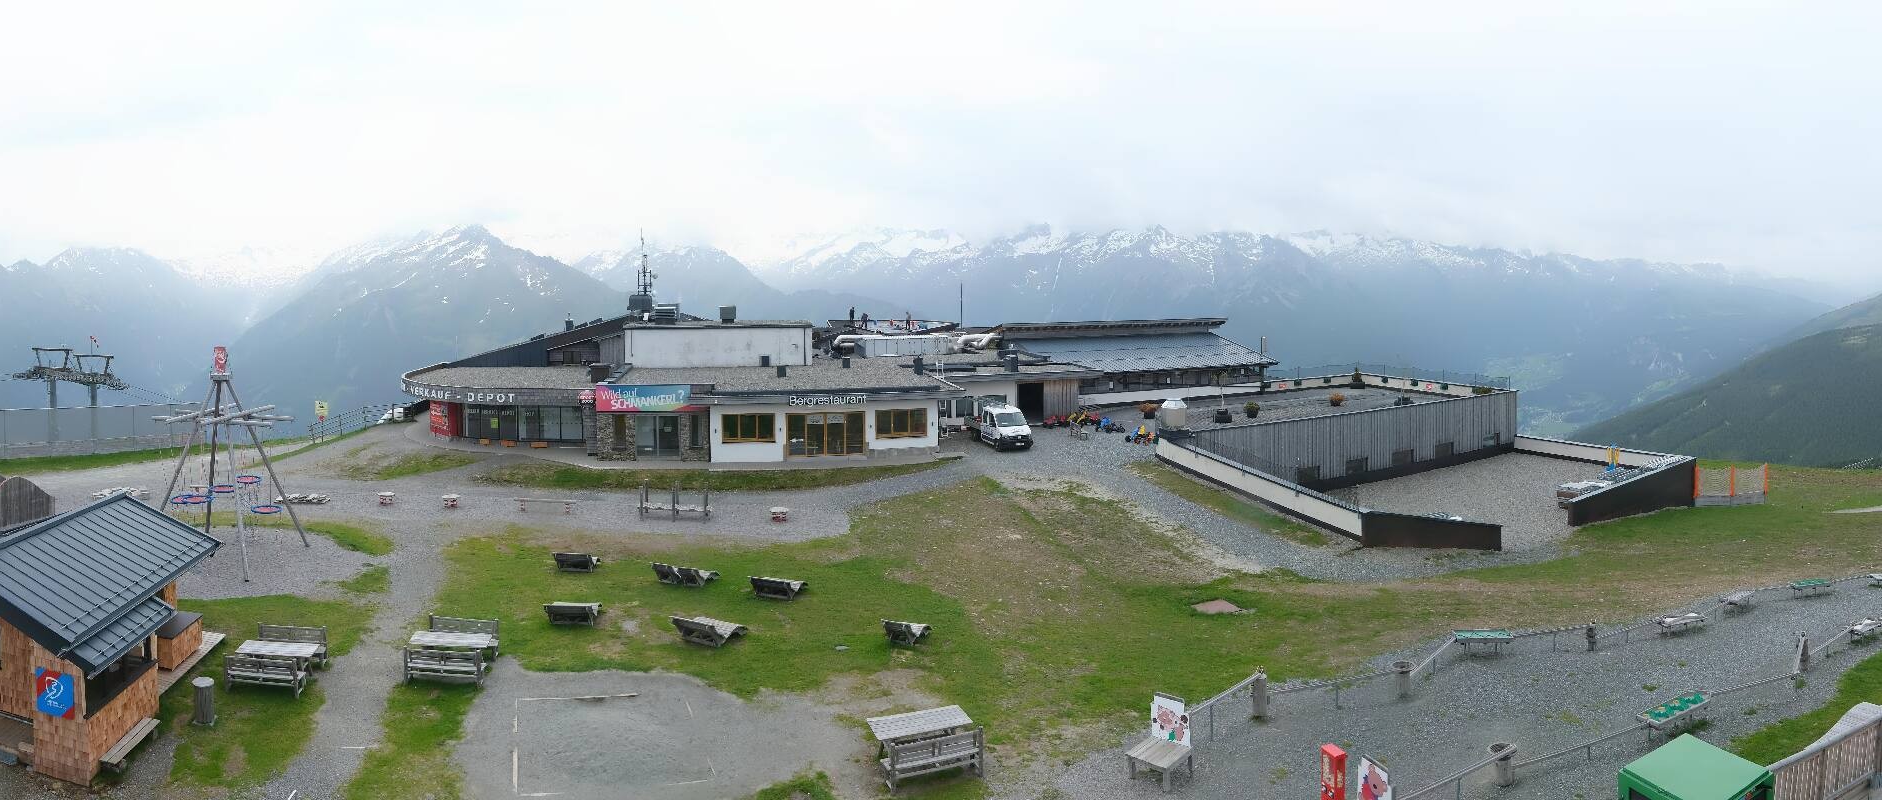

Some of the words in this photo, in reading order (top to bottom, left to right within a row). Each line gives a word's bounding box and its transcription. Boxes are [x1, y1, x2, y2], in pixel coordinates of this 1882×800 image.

[410, 385, 451, 400] VERKAUF
[467, 392, 515, 402] DEPOT
[601, 388, 621, 400] Wild
[623, 388, 638, 398] auf
[789, 395, 867, 407] Bergrestaurant
